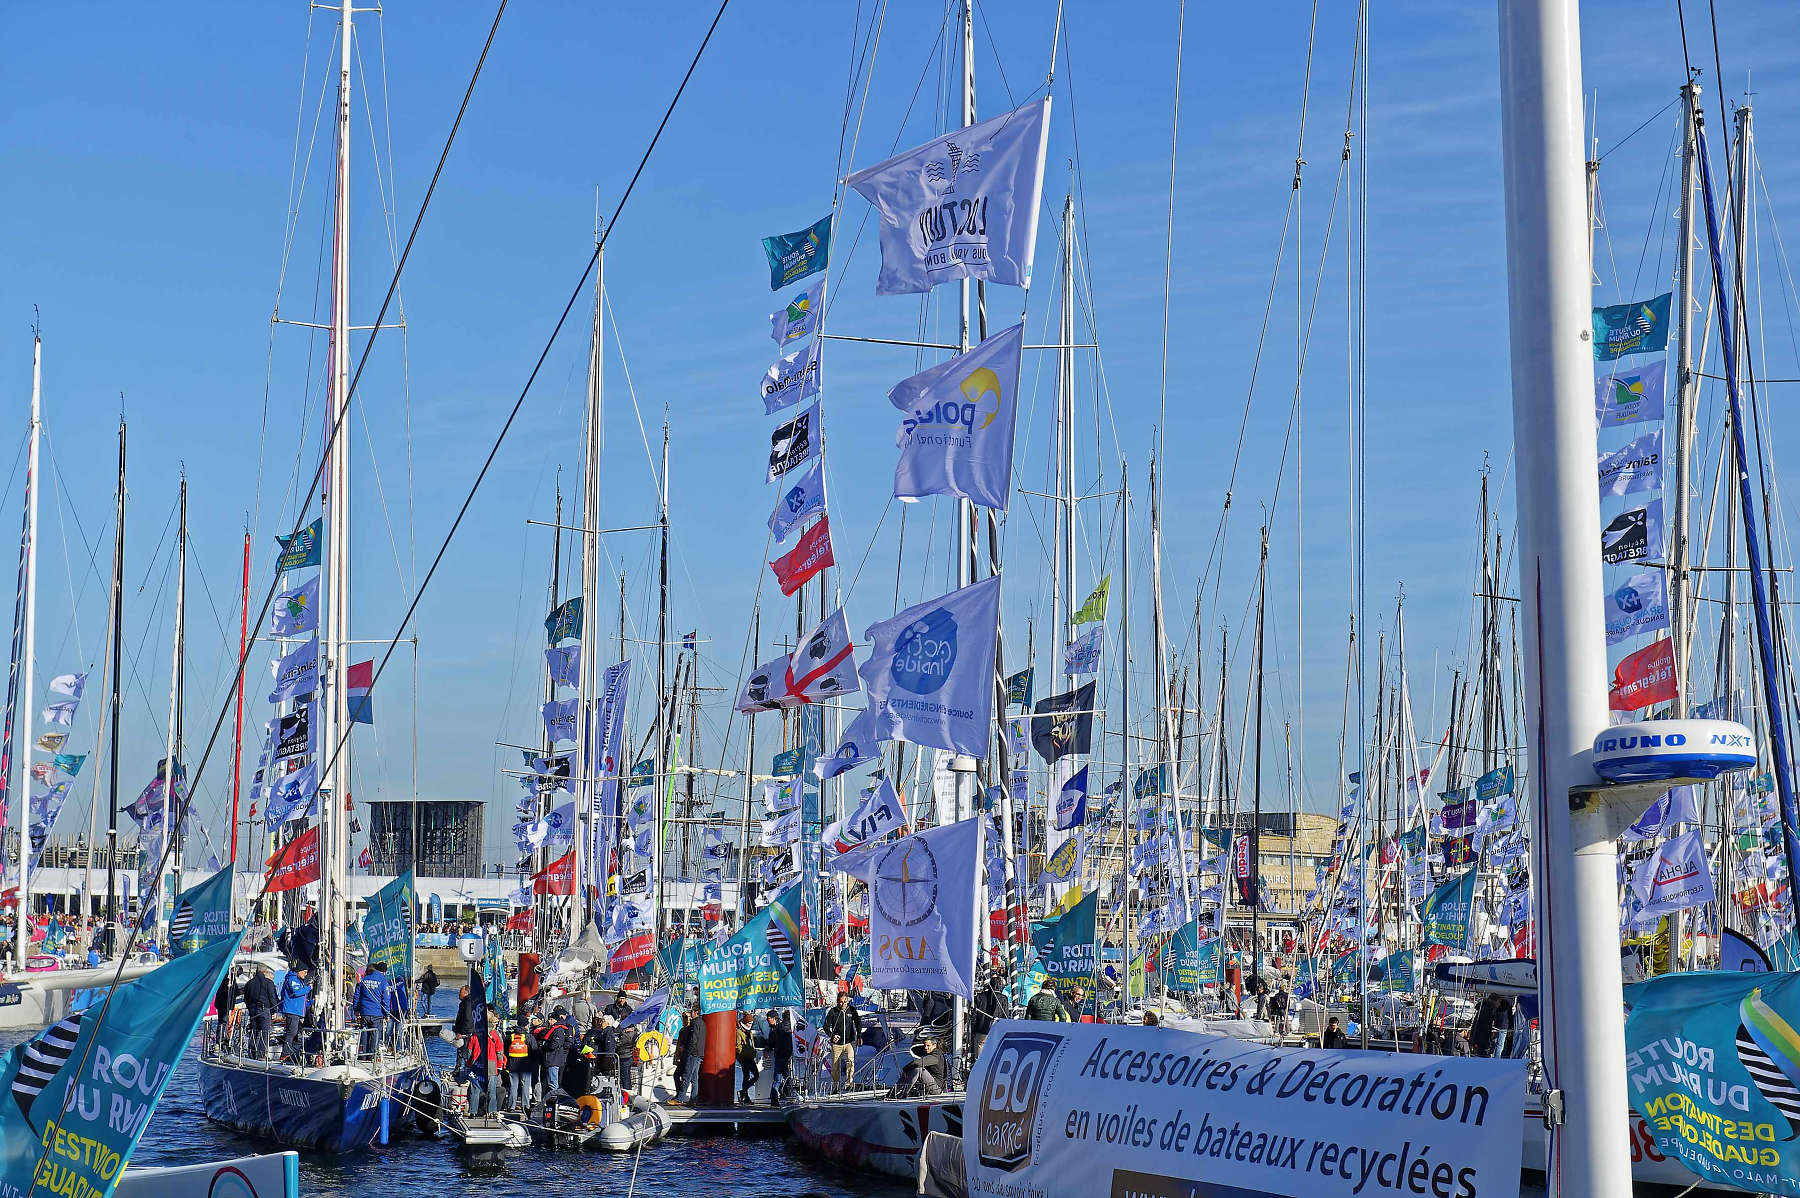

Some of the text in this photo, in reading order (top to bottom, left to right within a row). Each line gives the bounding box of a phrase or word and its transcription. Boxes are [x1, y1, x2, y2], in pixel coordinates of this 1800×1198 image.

[1710, 734, 1752, 747] NXT
[1237, 836, 1250, 878] Veedol
[63, 1076, 100, 1121] DU
[1080, 1036, 1489, 1127] Accessoires & Décoration
[1065, 1103, 1478, 1198] en voiles de bateaux recyclées
